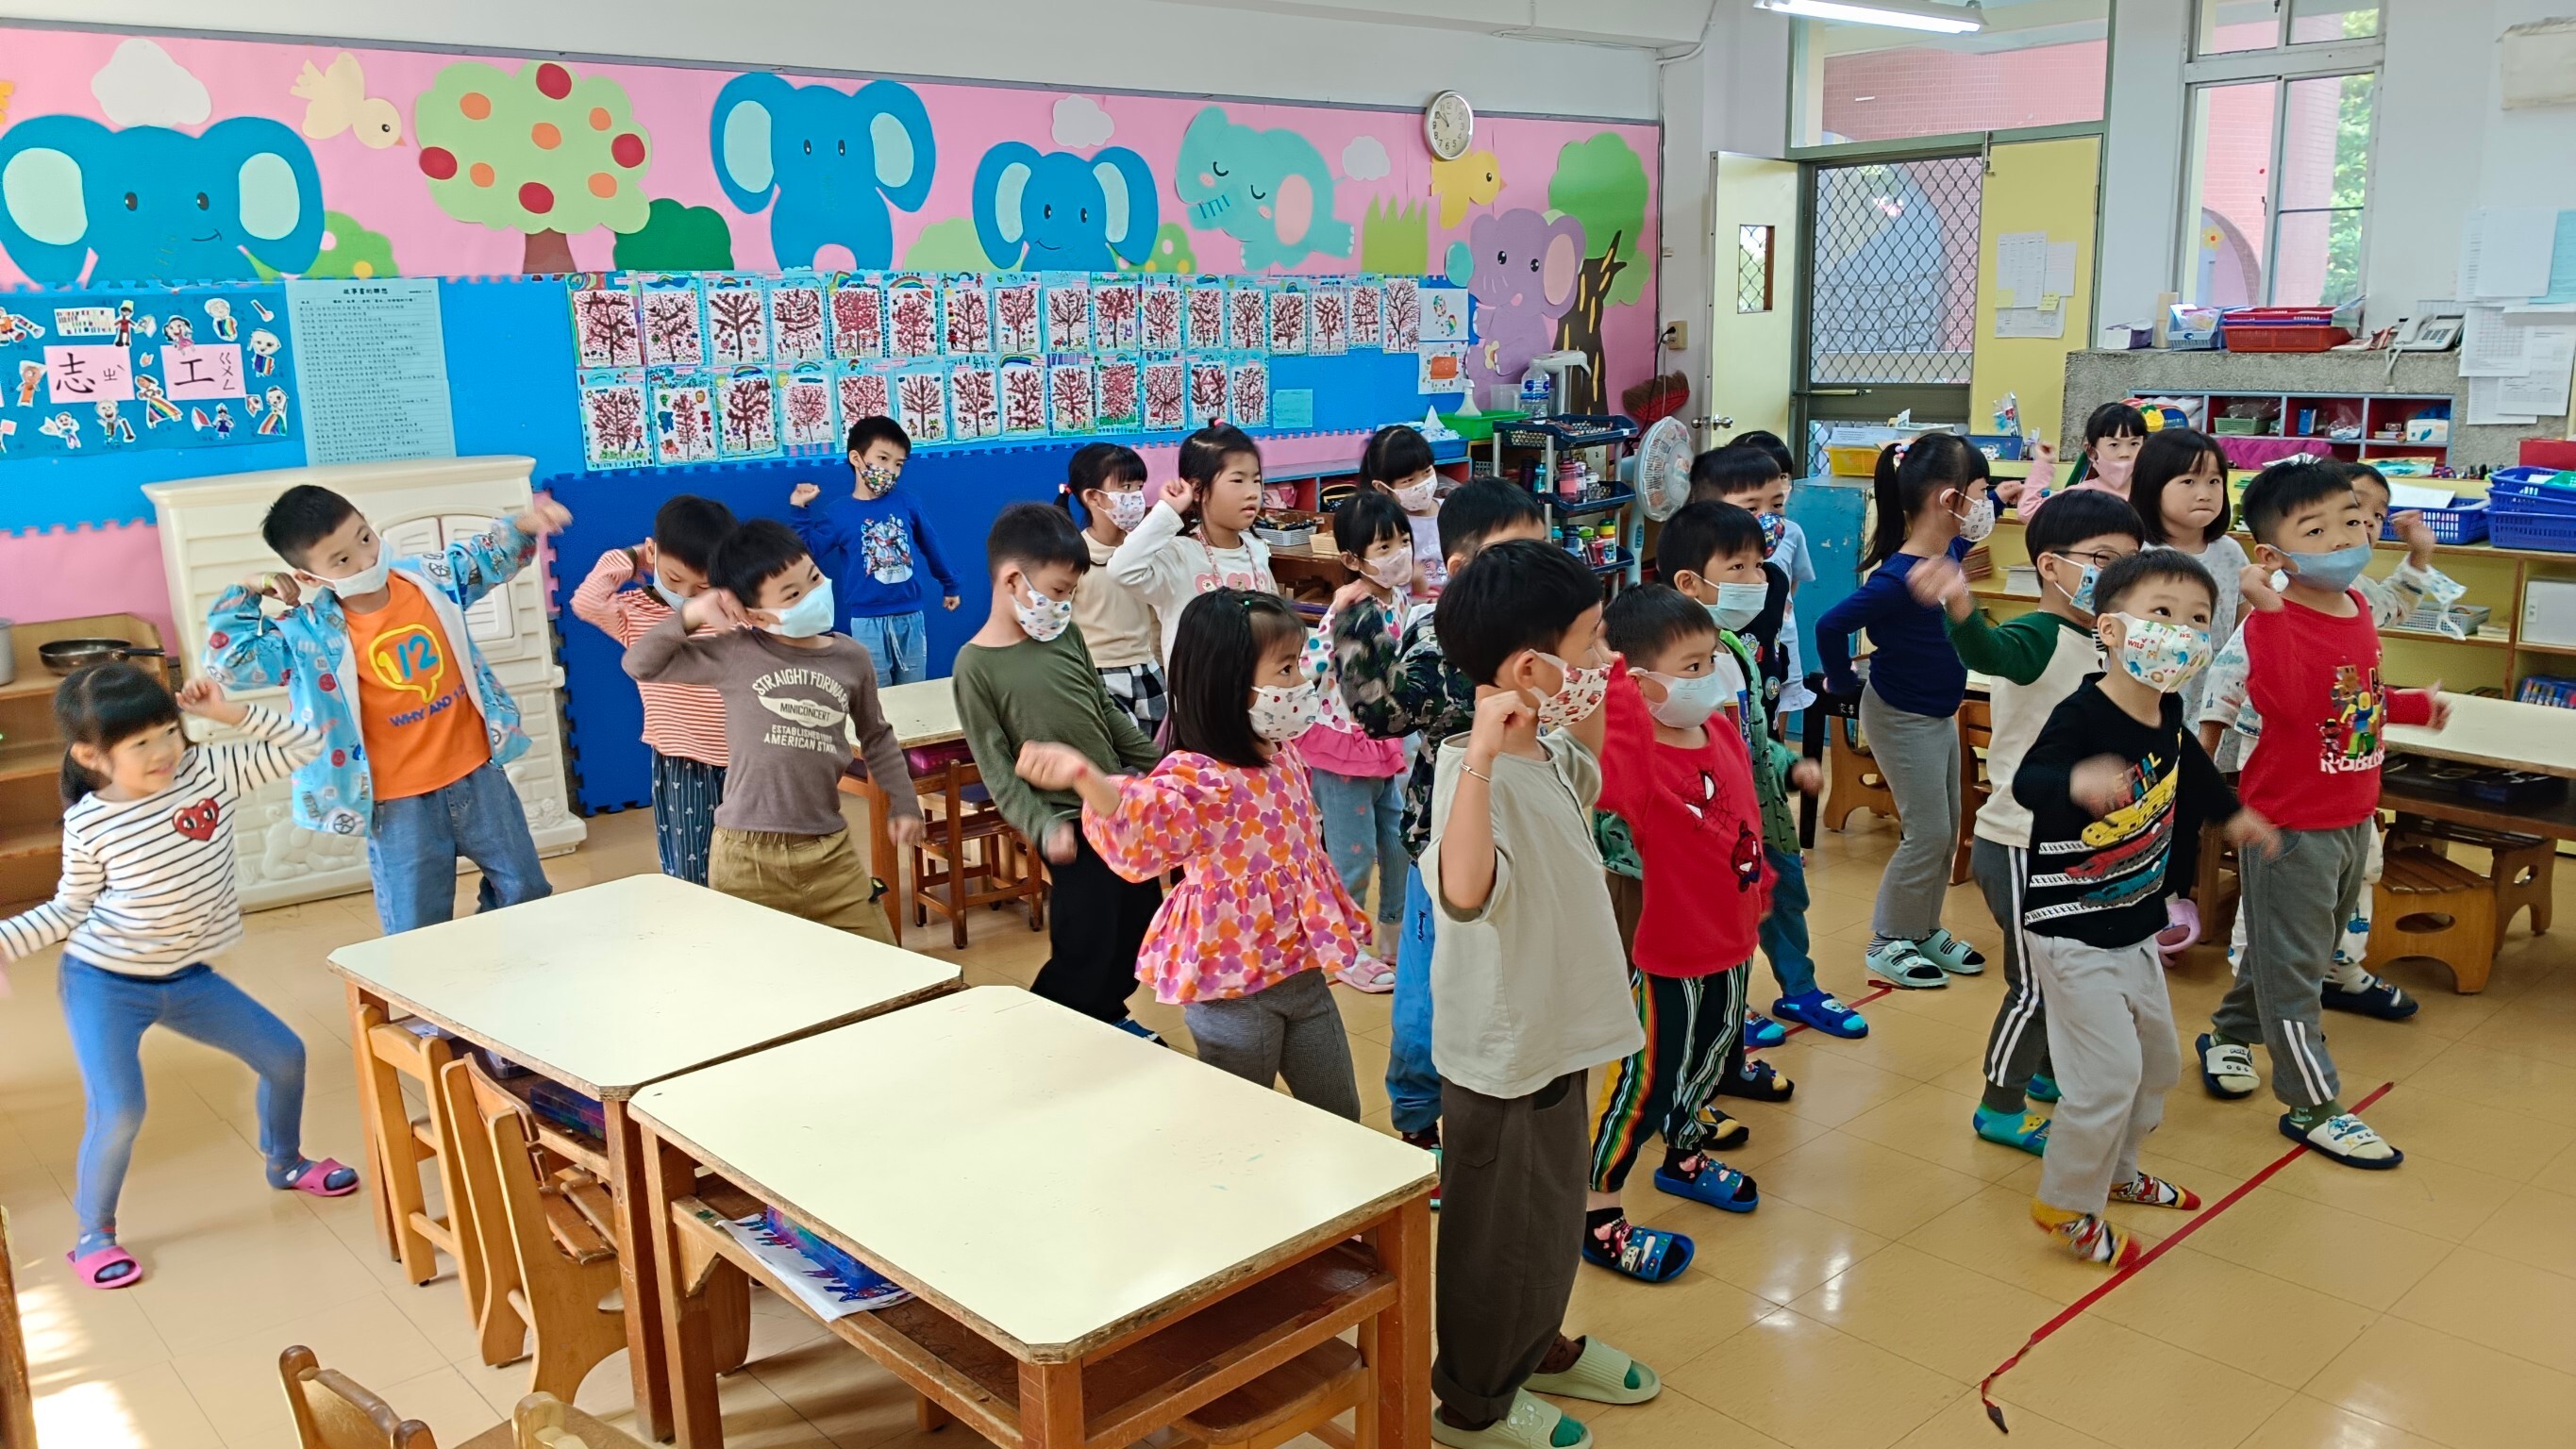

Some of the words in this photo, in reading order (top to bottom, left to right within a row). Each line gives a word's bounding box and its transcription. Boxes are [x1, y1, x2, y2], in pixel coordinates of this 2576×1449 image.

[1447, 101, 1453, 110] 12
[1432, 121, 1437, 130] 9
[1433, 131, 1439, 141] 8
[1438, 139, 1444, 148] 7
[1445, 142, 1450, 151] 6
[1451, 139, 1457, 148] 5
[56, 352, 96, 394] 志
[174, 358, 215, 387] 工
[752, 668, 809, 696] STRAIGHT
[428, 695, 452, 716] AND
[772, 724, 821, 741] ESTABLISHED
[763, 732, 816, 751] AMERICAN
